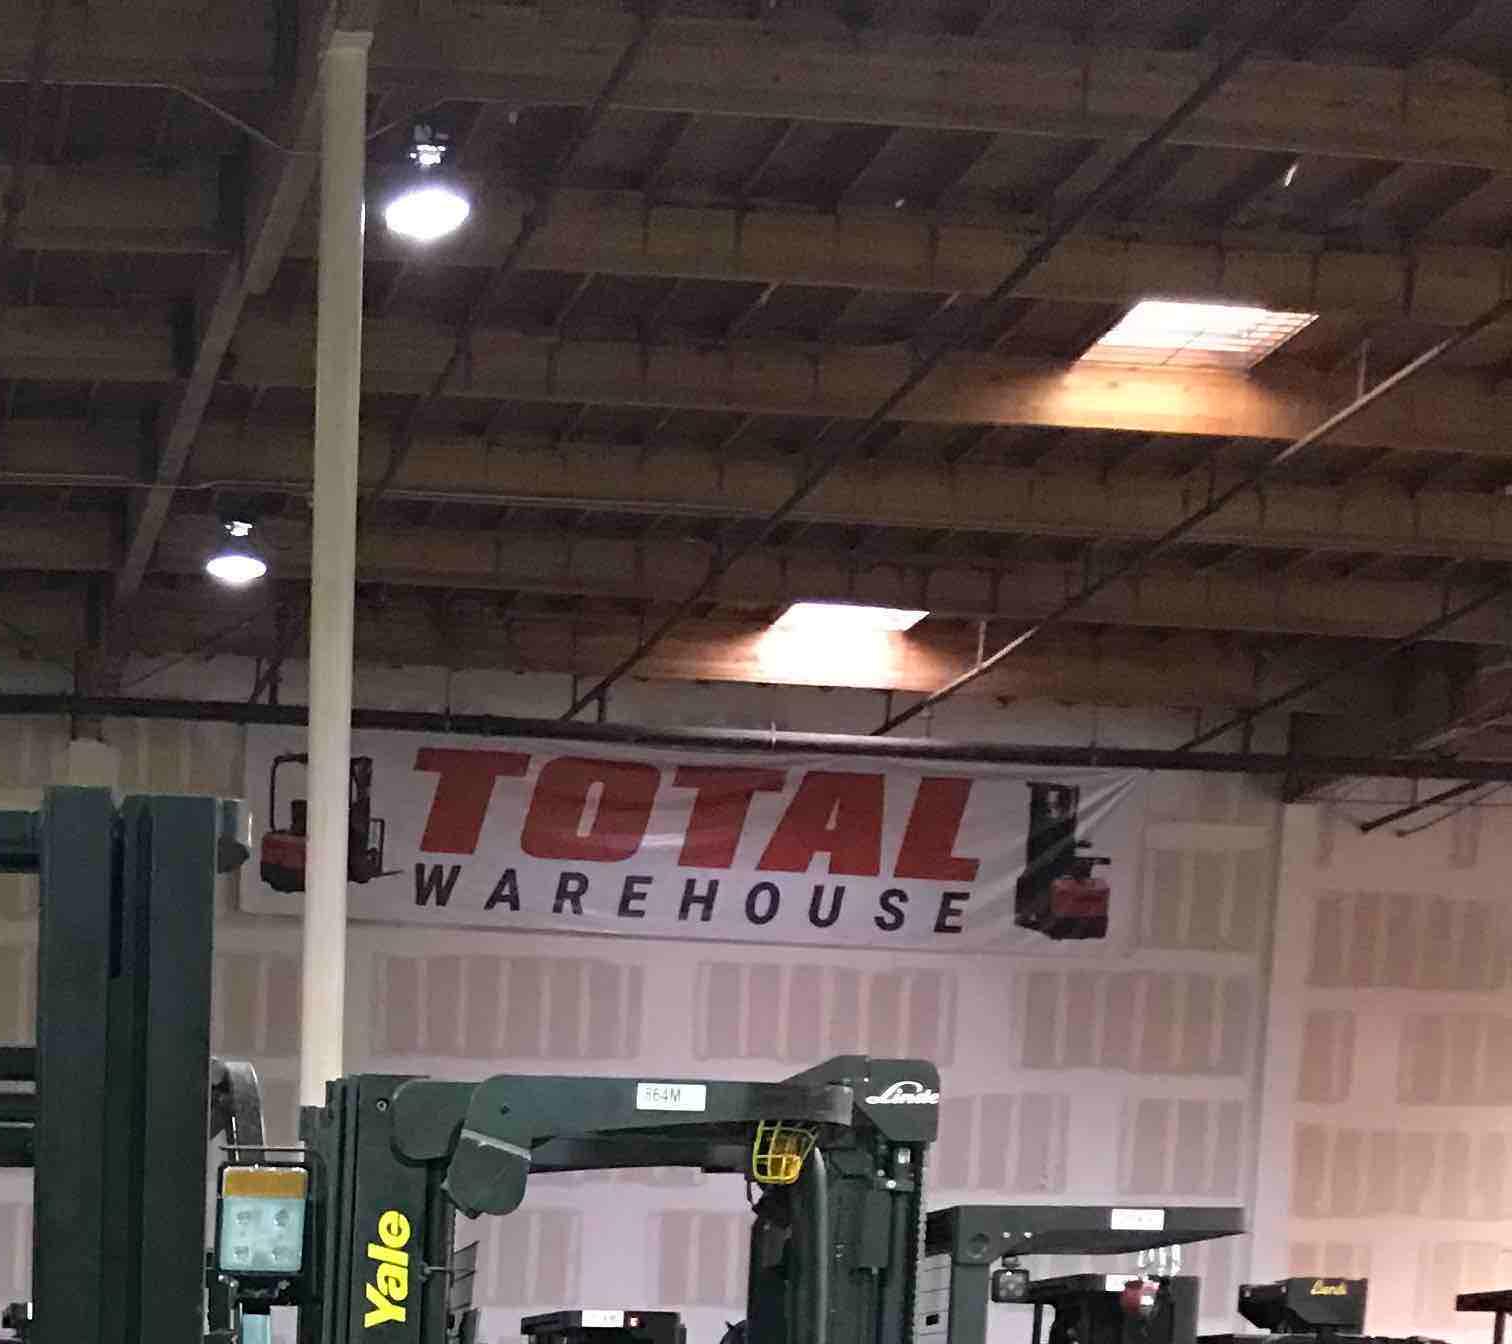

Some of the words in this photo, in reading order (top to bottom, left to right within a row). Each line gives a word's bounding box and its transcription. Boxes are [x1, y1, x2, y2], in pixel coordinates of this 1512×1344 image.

[414, 748, 980, 881] TOTAL
[414, 863, 971, 933] WAREHOUSE
[865, 1080, 940, 1105] Linde
[364, 1210, 410, 1328] Yale
